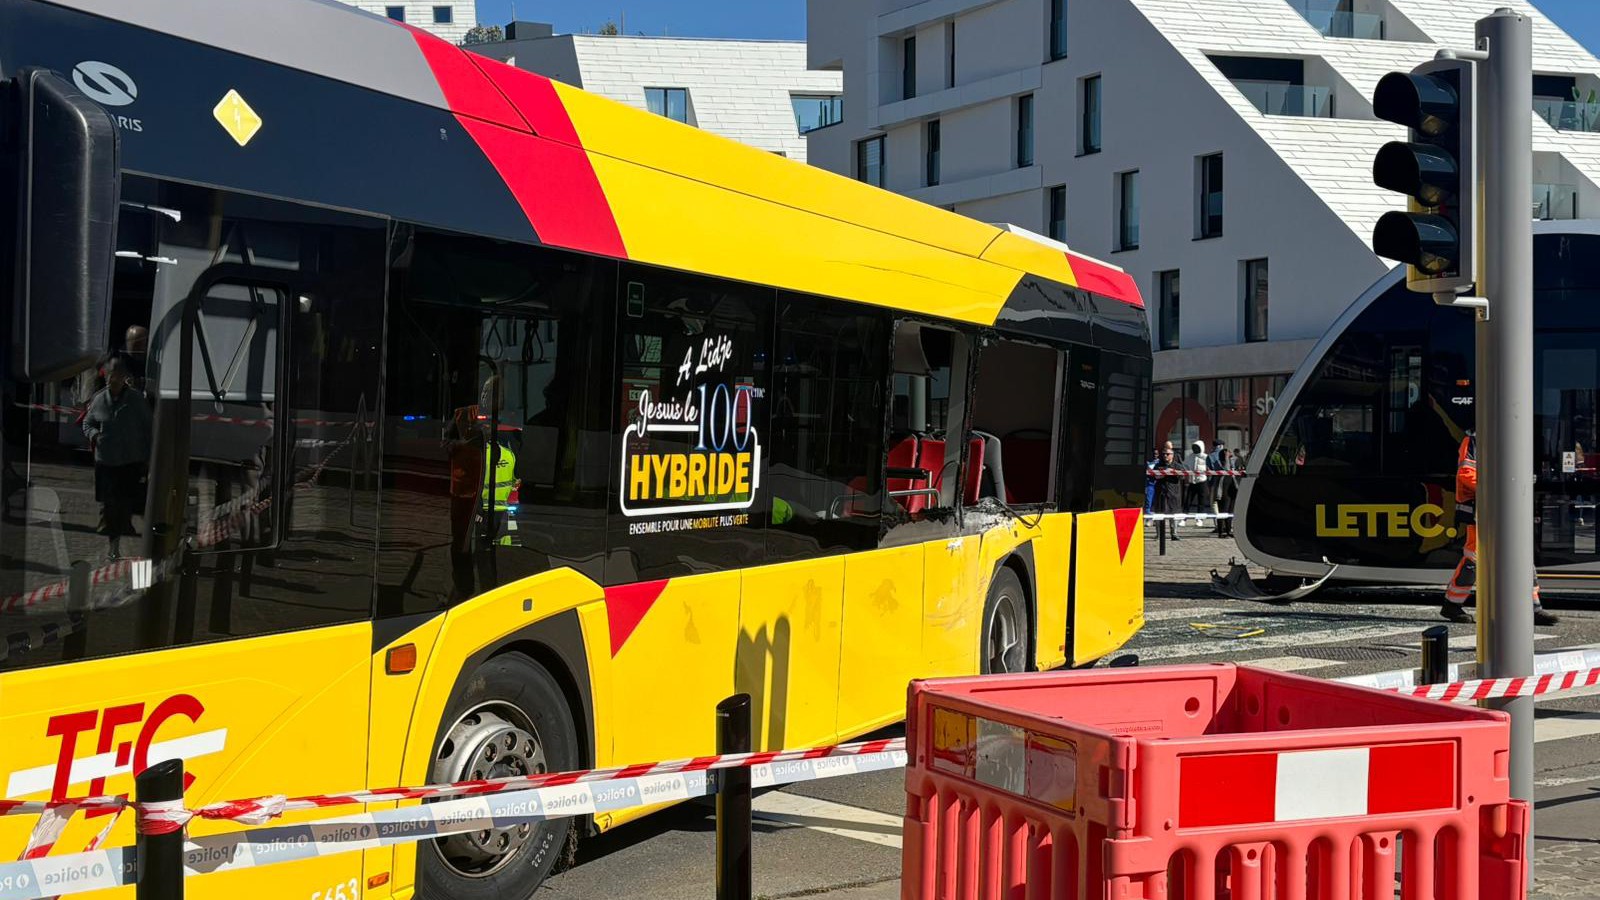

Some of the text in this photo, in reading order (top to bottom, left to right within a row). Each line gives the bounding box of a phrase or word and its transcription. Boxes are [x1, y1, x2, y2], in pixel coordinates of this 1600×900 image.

[111, 114, 143, 132] RIS
[676, 346, 692, 386] A
[629, 452, 751, 500] HYBRIDE
[629, 521, 661, 535] ENSEMBLE
[662, 519, 679, 531] POUR
[680, 518, 692, 530] UNE
[719, 516, 733, 526] PLUS
[733, 514, 749, 526] VERTE
[46, 694, 204, 819] TEC
